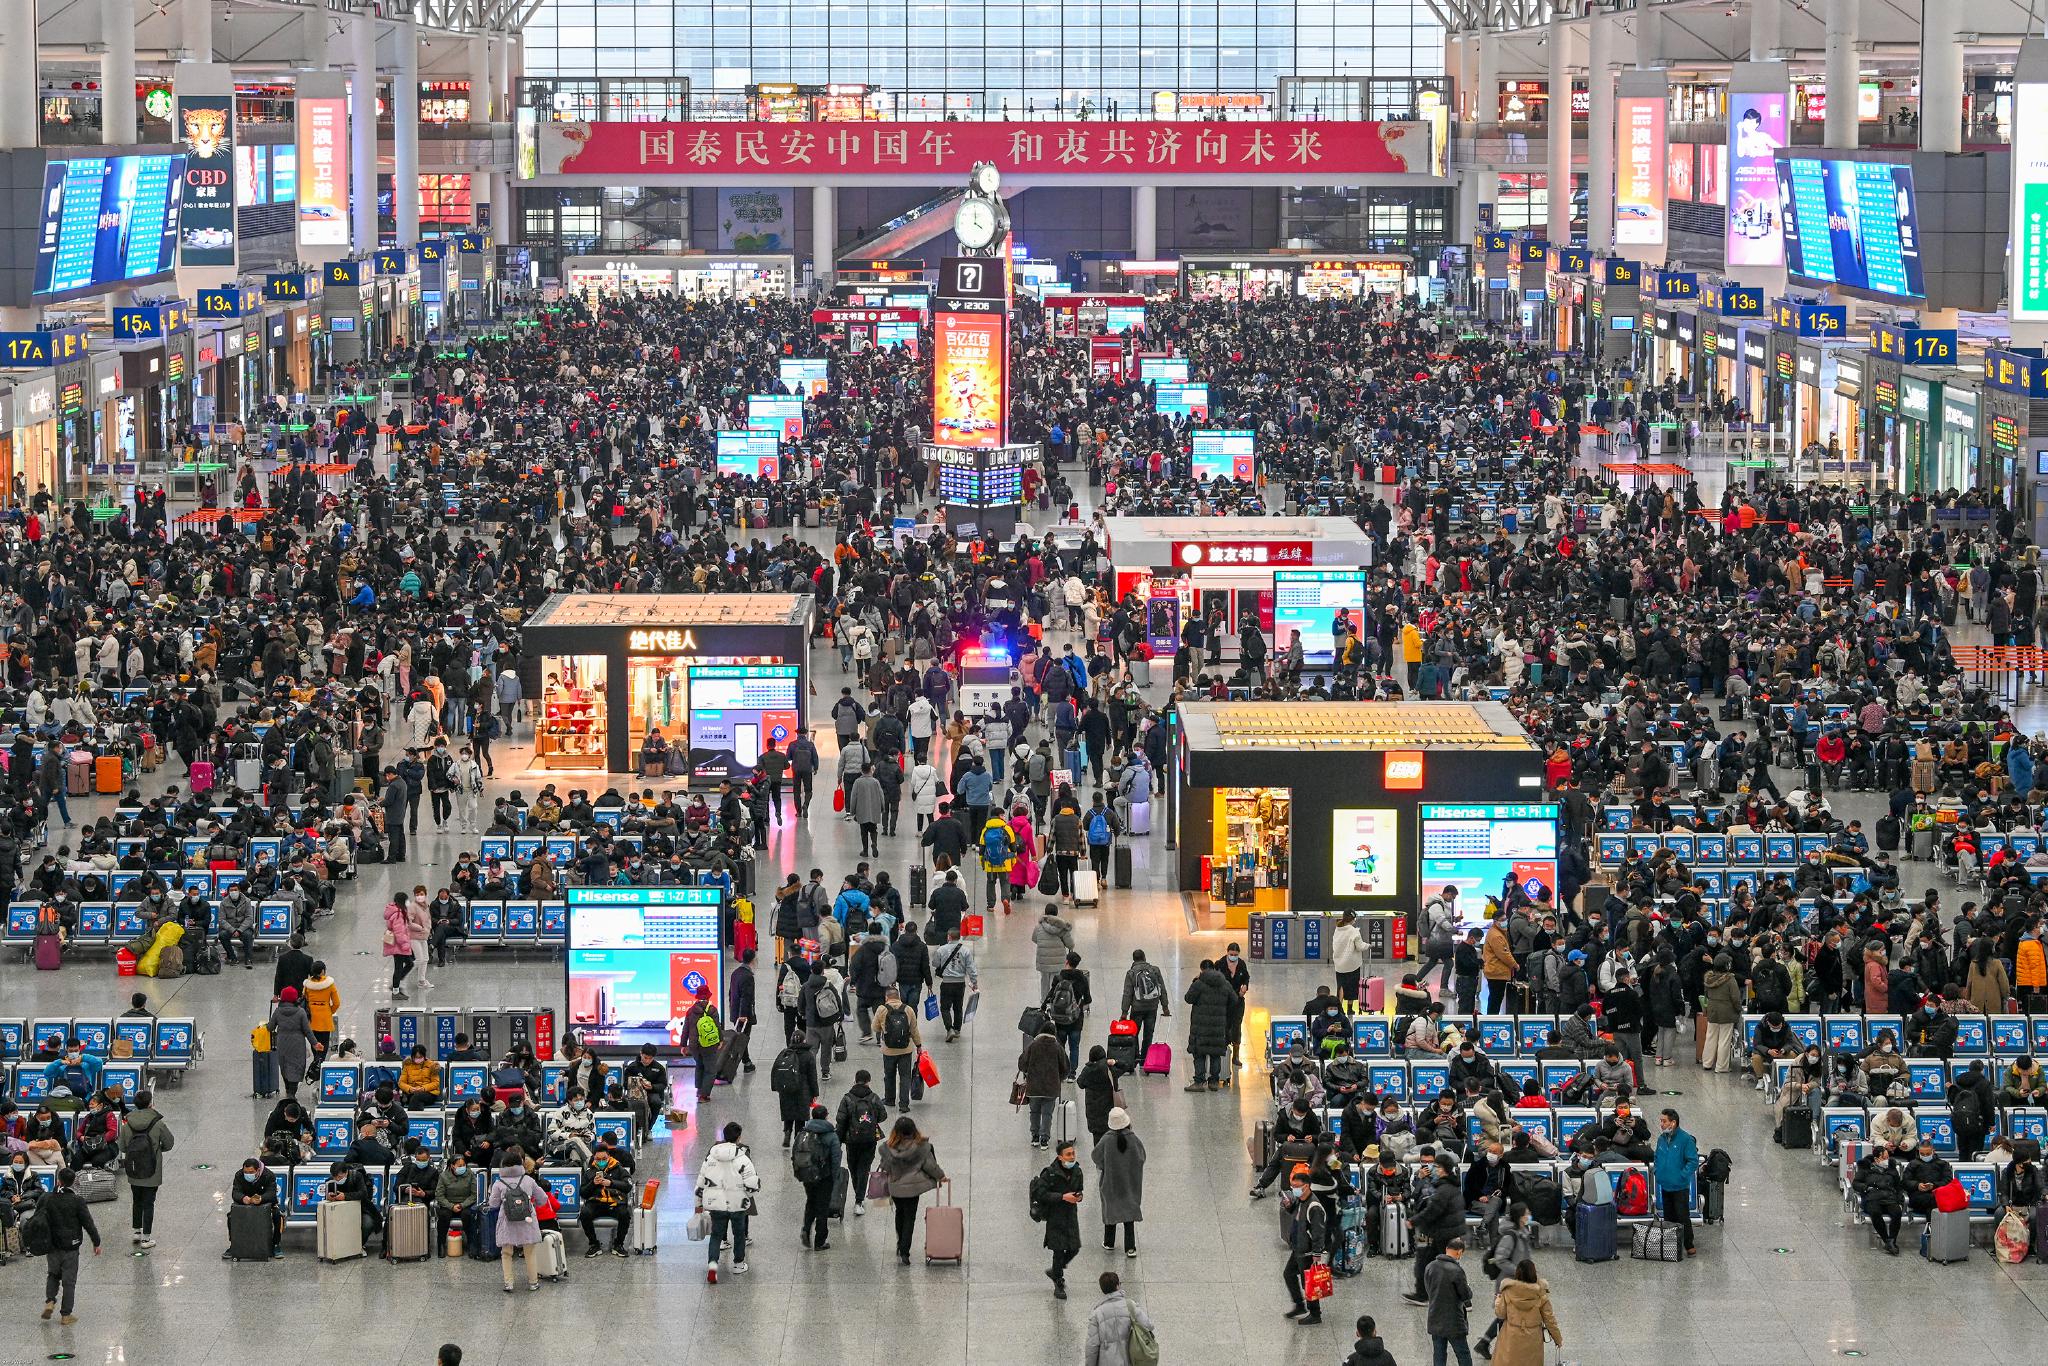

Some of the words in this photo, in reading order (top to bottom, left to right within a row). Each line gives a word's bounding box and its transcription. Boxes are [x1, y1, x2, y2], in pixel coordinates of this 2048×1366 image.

[640, 129, 956, 166] 国泰民安中国年
[1007, 128, 1323, 166] 和衷共济向未来
[186, 169, 227, 186] CBD
[195, 186, 217, 198] 家居
[462, 239, 475, 250] 3A
[1493, 237, 1506, 249] 3B
[424, 247, 438, 259] 5A
[1529, 246, 1543, 258] 5B
[381, 256, 397, 269] 7A
[1568, 255, 1584, 268] 7B
[333, 267, 349, 281] 9A
[1615, 266, 1631, 280] 9B
[273, 280, 298, 295] 11A
[1665, 279, 1690, 293] 11B
[204, 295, 232, 311] 13A
[964, 301, 990, 310] 12306
[1729, 293, 1757, 309] 13B
[121, 314, 152, 332] 15A
[1808, 313, 1839, 330] 15B
[945, 331, 990, 347] 百亿红包
[8, 339, 43, 359] 17A
[1914, 337, 1949, 357] 17B
[1208, 547, 1268, 563] 旅友书屋
[1281, 572, 1318, 580] Hisense
[696, 667, 741, 677] Hisense
[1430, 807, 1487, 819] Hisense
[577, 890, 640, 902] Hisense
[667, 891, 685, 901] 1-27
